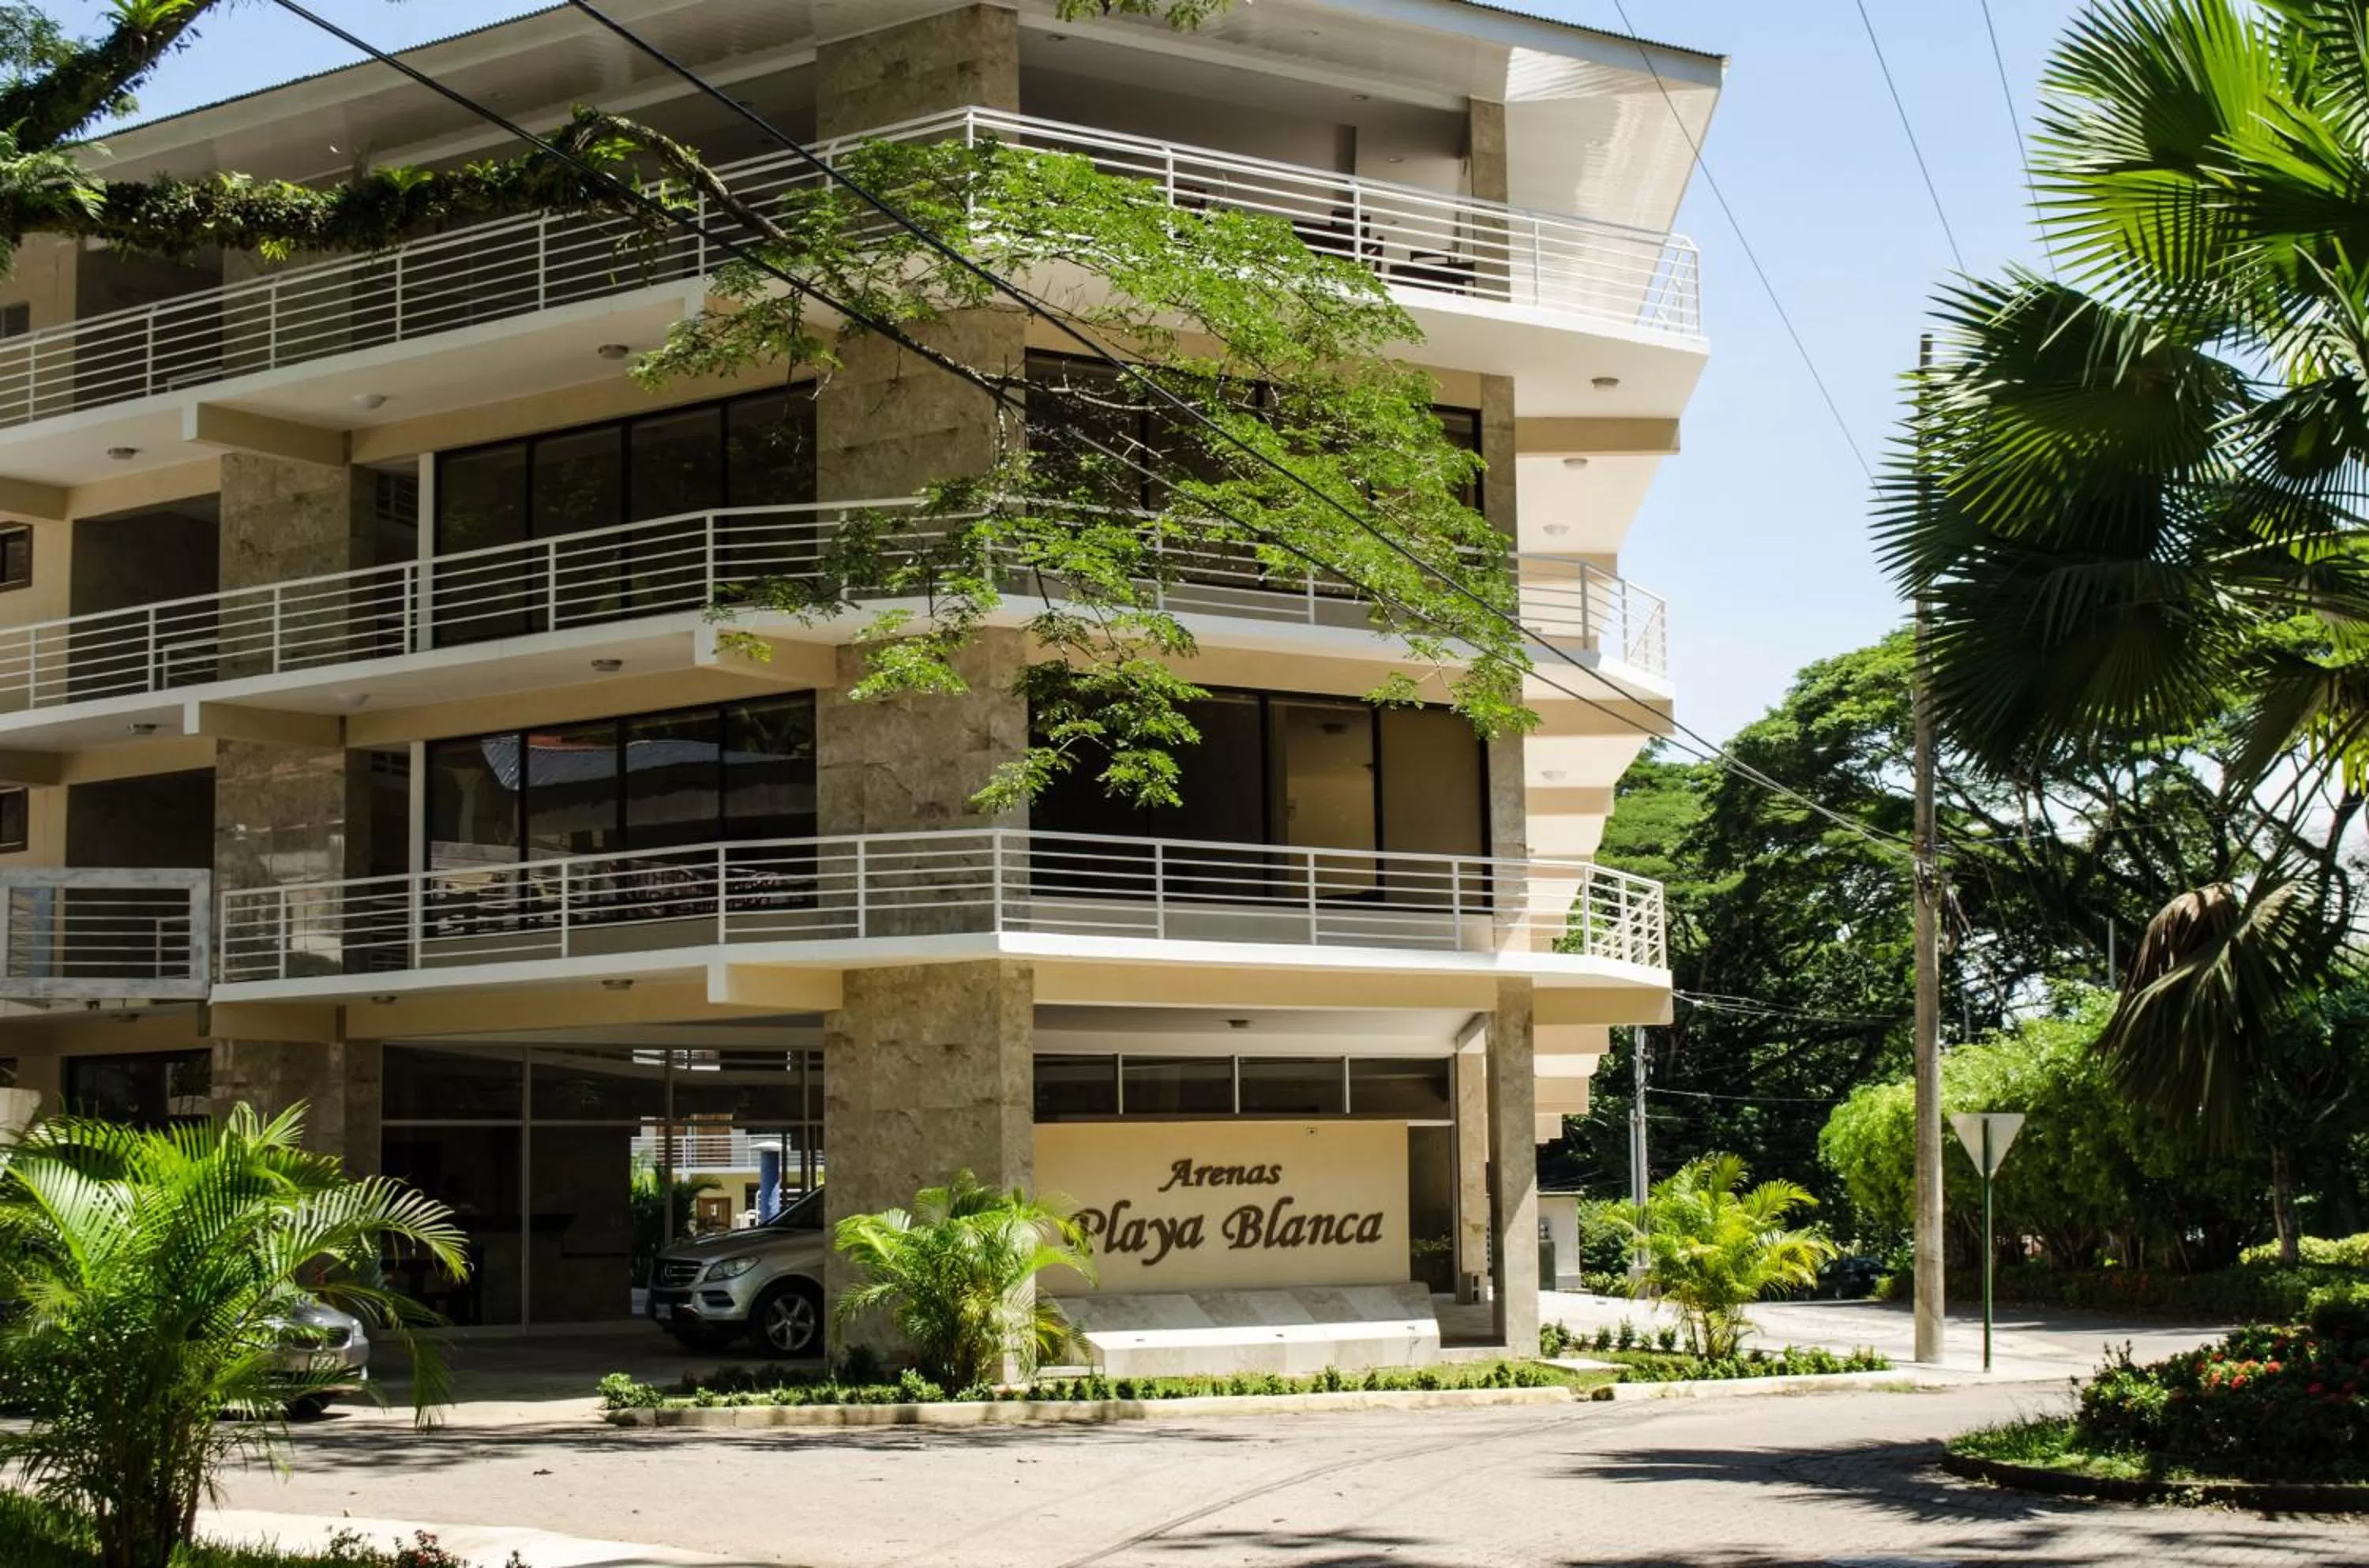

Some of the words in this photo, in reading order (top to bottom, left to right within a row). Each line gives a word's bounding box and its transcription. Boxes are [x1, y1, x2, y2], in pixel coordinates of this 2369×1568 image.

[1158, 1158, 1282, 1191] Arenas
[1063, 1199, 1205, 1266] Playa
[1221, 1196, 1383, 1250] Blanca
